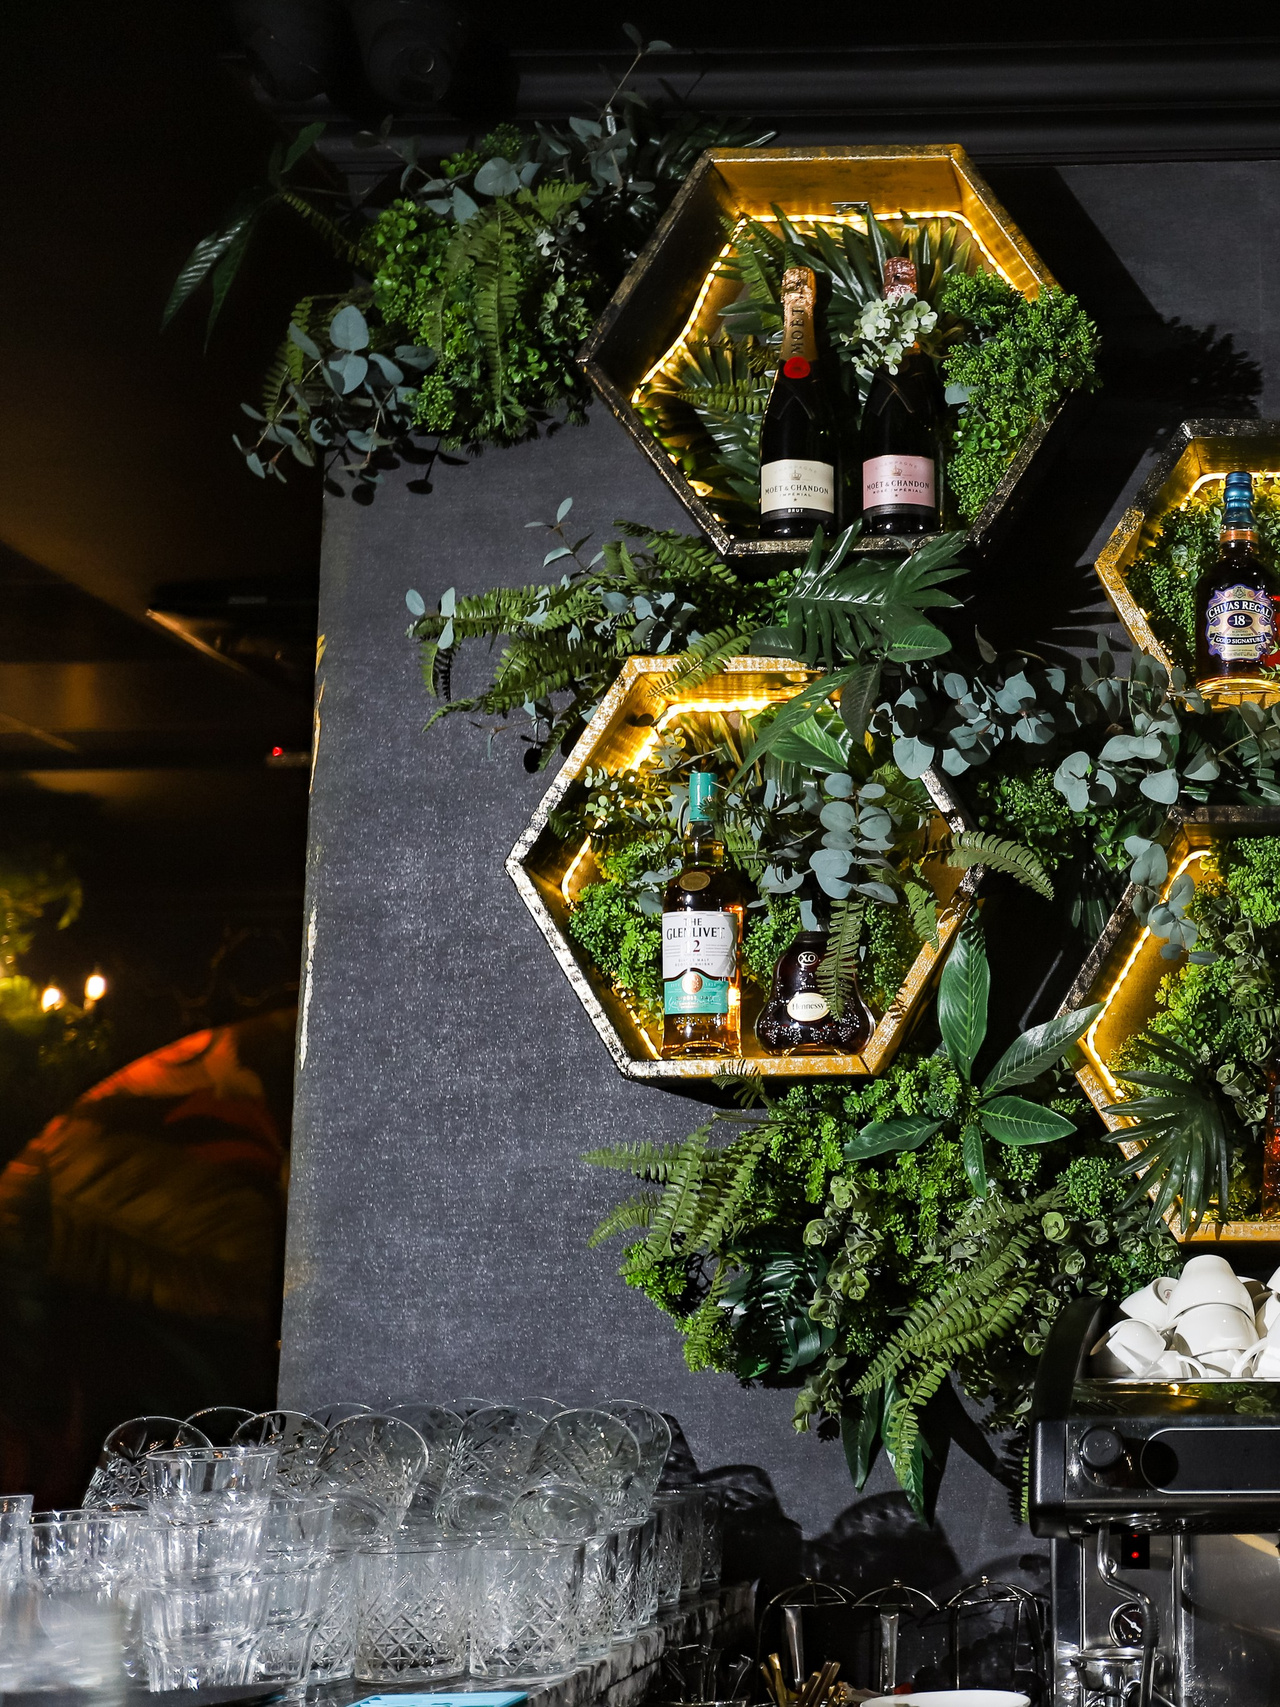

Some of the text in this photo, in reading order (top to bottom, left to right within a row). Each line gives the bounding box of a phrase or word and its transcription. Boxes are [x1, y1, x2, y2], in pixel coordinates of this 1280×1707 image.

[790, 484, 829, 495] CHANDON
[891, 480, 930, 489] CHANDON
[1208, 600, 1271, 618] CHIVAS REGAL
[1233, 614, 1246, 626] 18
[1215, 636, 1266, 644] GOD SIGNATURE
[683, 917, 703, 927] THE
[801, 954, 816, 963] XO
